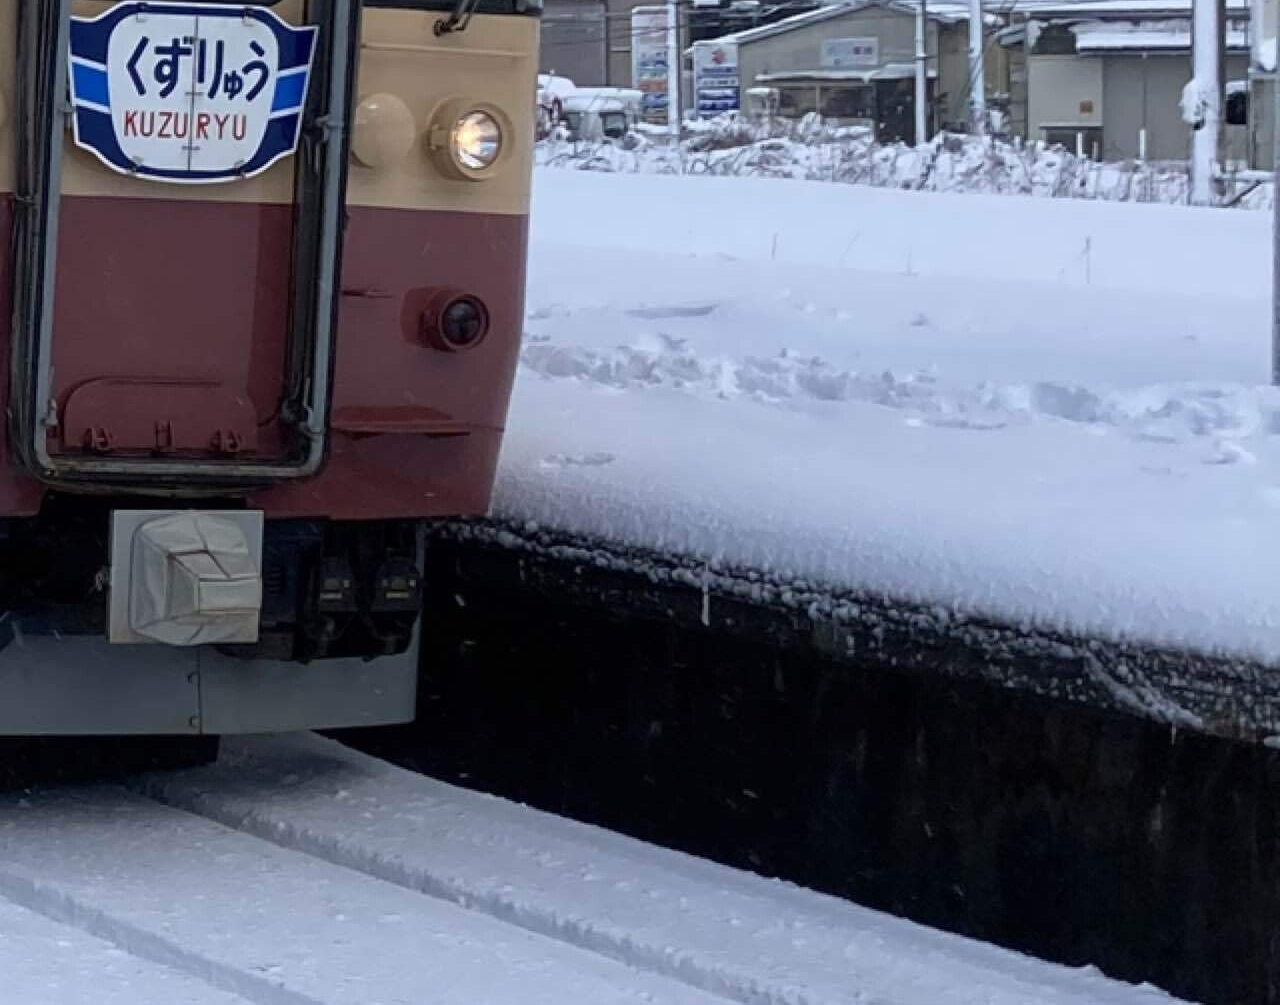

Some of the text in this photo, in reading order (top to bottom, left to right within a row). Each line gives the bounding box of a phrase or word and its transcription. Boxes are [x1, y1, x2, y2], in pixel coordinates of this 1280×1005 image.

[126, 35, 269, 101] くずりゅう
[123, 110, 247, 140] KUZURYU
